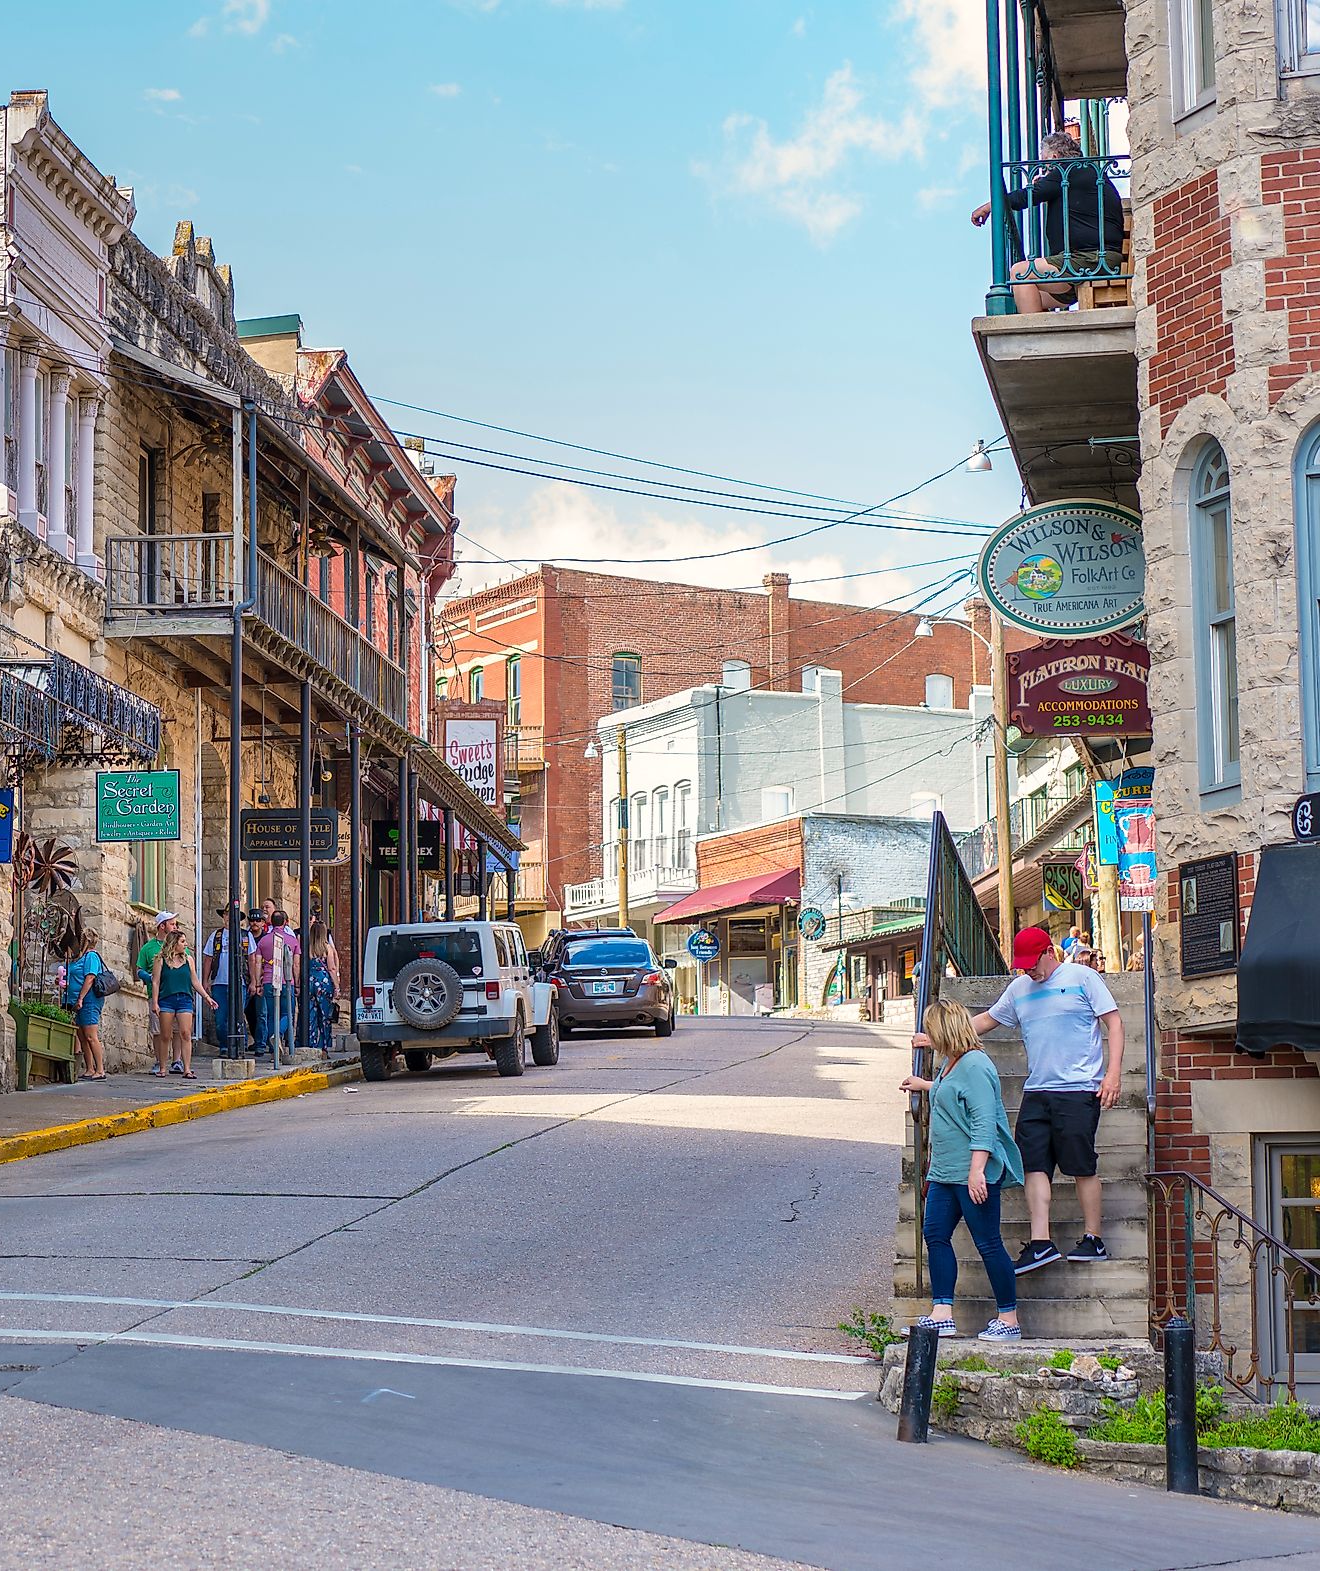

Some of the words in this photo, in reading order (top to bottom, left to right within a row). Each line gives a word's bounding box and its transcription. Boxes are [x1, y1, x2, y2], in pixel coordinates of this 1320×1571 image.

[1006, 519, 1091, 555] WILSON
[1092, 524, 1106, 541] &
[1053, 536, 1139, 565] WILSON
[1071, 567, 1119, 584] FolkArt
[1033, 602, 1053, 613] TRUE
[1056, 599, 1100, 612] AMERICANA
[1102, 597, 1118, 609] ART
[1017, 655, 1101, 707] FLATIRON
[1104, 655, 1149, 684] FLAT
[1064, 679, 1113, 691] LUXURY
[1037, 699, 1139, 712] ACCOMMODATIONS
[1053, 713, 1124, 727] 253-9434
[449, 739, 492, 766] Sweet's
[125, 775, 142, 783] The
[102, 781, 153, 800] Secret
[470, 785, 496, 801] hen
[116, 798, 175, 819] Garden
[102, 821, 136, 829] Birdhouses
[140, 819, 163, 828] Garden
[246, 823, 281, 834] HOUSE
[284, 825, 298, 833] OF
[309, 824, 331, 833] TYLE
[378, 847, 398, 856] TEE
